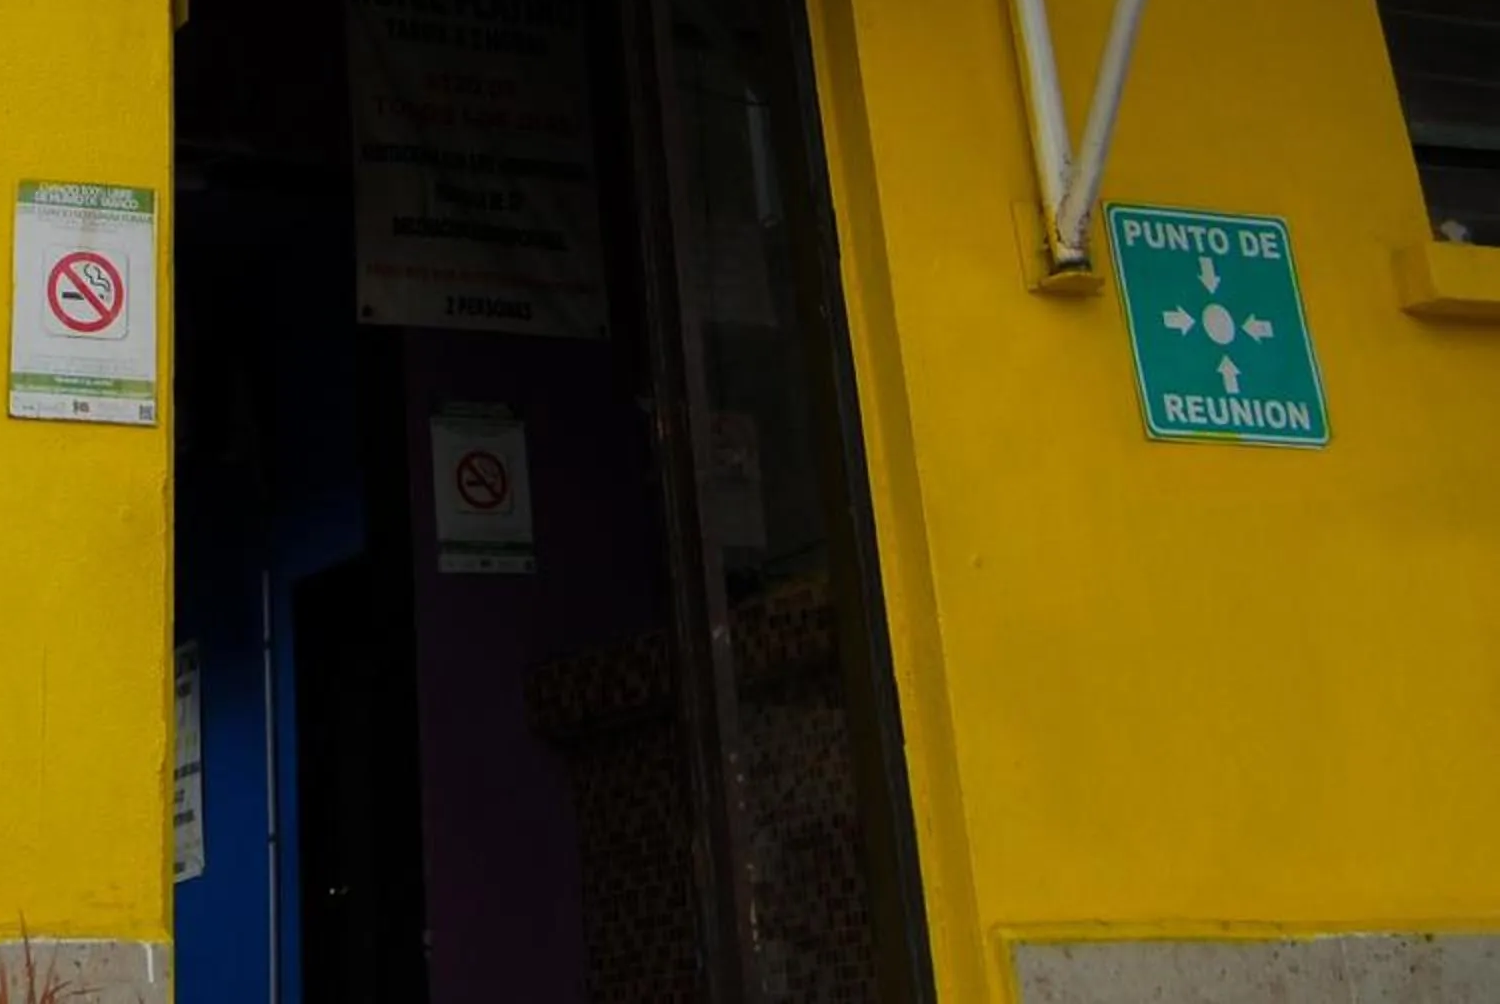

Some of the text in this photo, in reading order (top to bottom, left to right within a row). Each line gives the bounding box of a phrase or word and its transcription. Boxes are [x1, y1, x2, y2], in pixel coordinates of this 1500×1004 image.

[1122, 219, 1282, 260] PUNTO DE
[1163, 393, 1312, 430] REUNION
